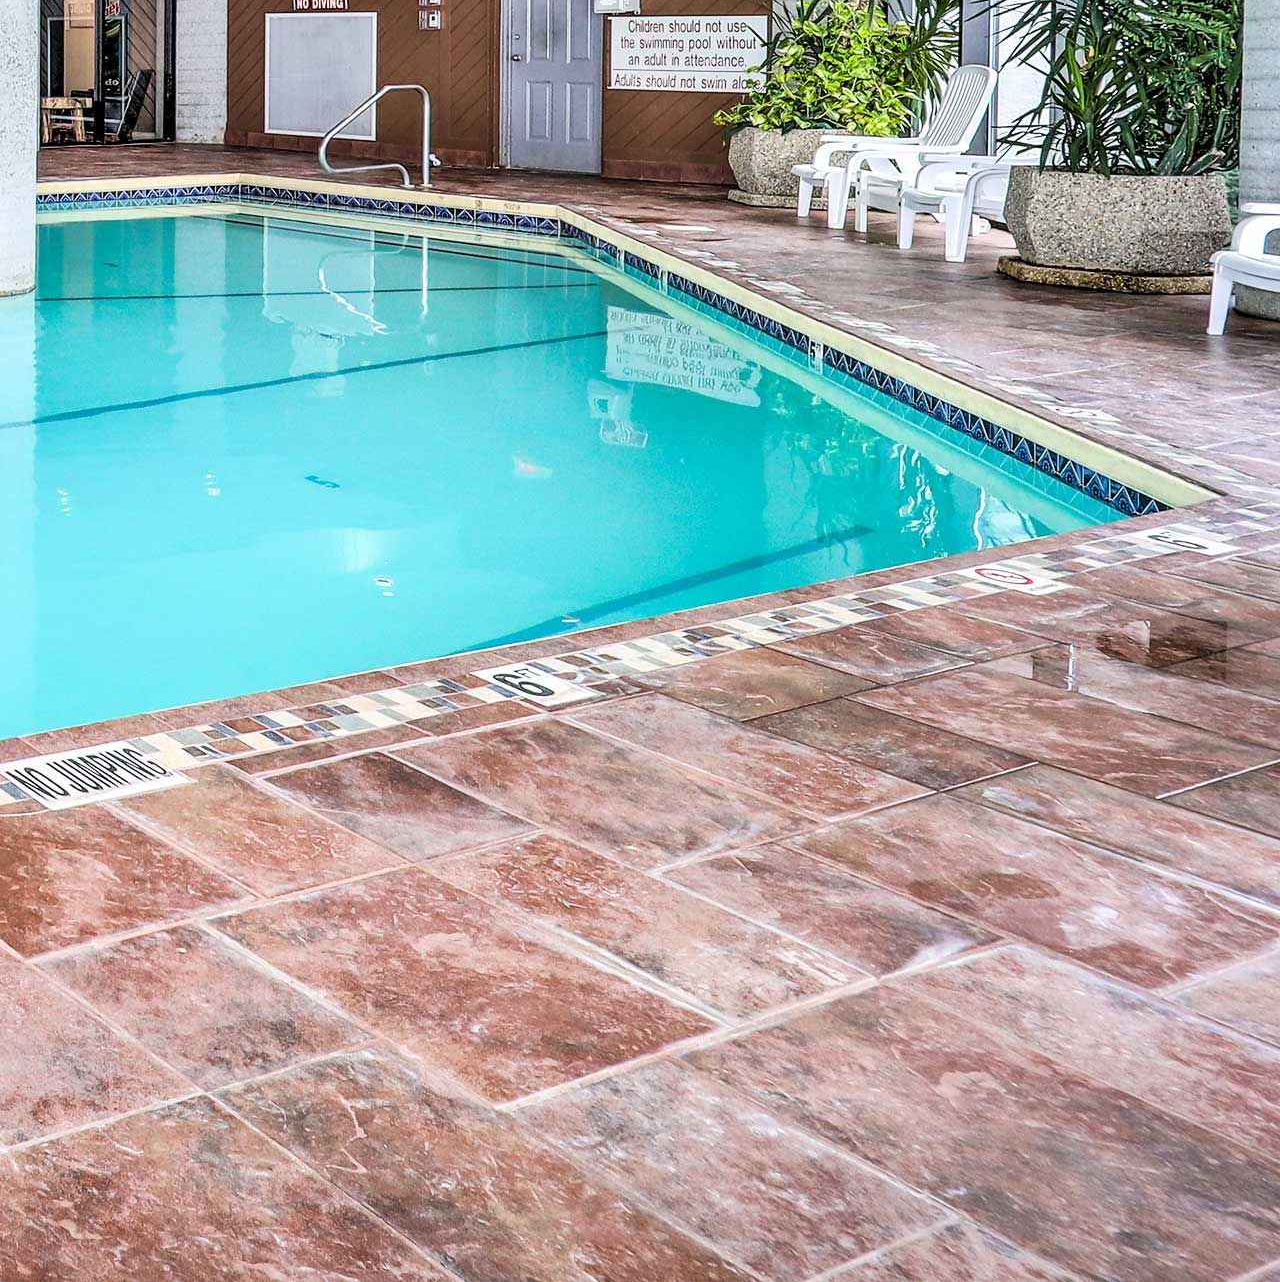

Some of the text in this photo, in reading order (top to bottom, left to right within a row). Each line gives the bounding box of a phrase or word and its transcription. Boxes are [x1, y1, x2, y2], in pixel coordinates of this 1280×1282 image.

[628, 19, 747, 33] Children should not use
[620, 35, 757, 53] the swimming pool without
[628, 55, 640, 66] an
[644, 53, 667, 66] adult
[671, 54, 680, 66] in
[614, 73, 641, 87] Adults
[645, 74, 677, 89] should
[680, 76, 696, 89] not
[701, 76, 727, 90] swim
[1147, 534, 1209, 550] 6
[493, 673, 555, 697] 6
[5, 748, 174, 801] NO JUMPING
